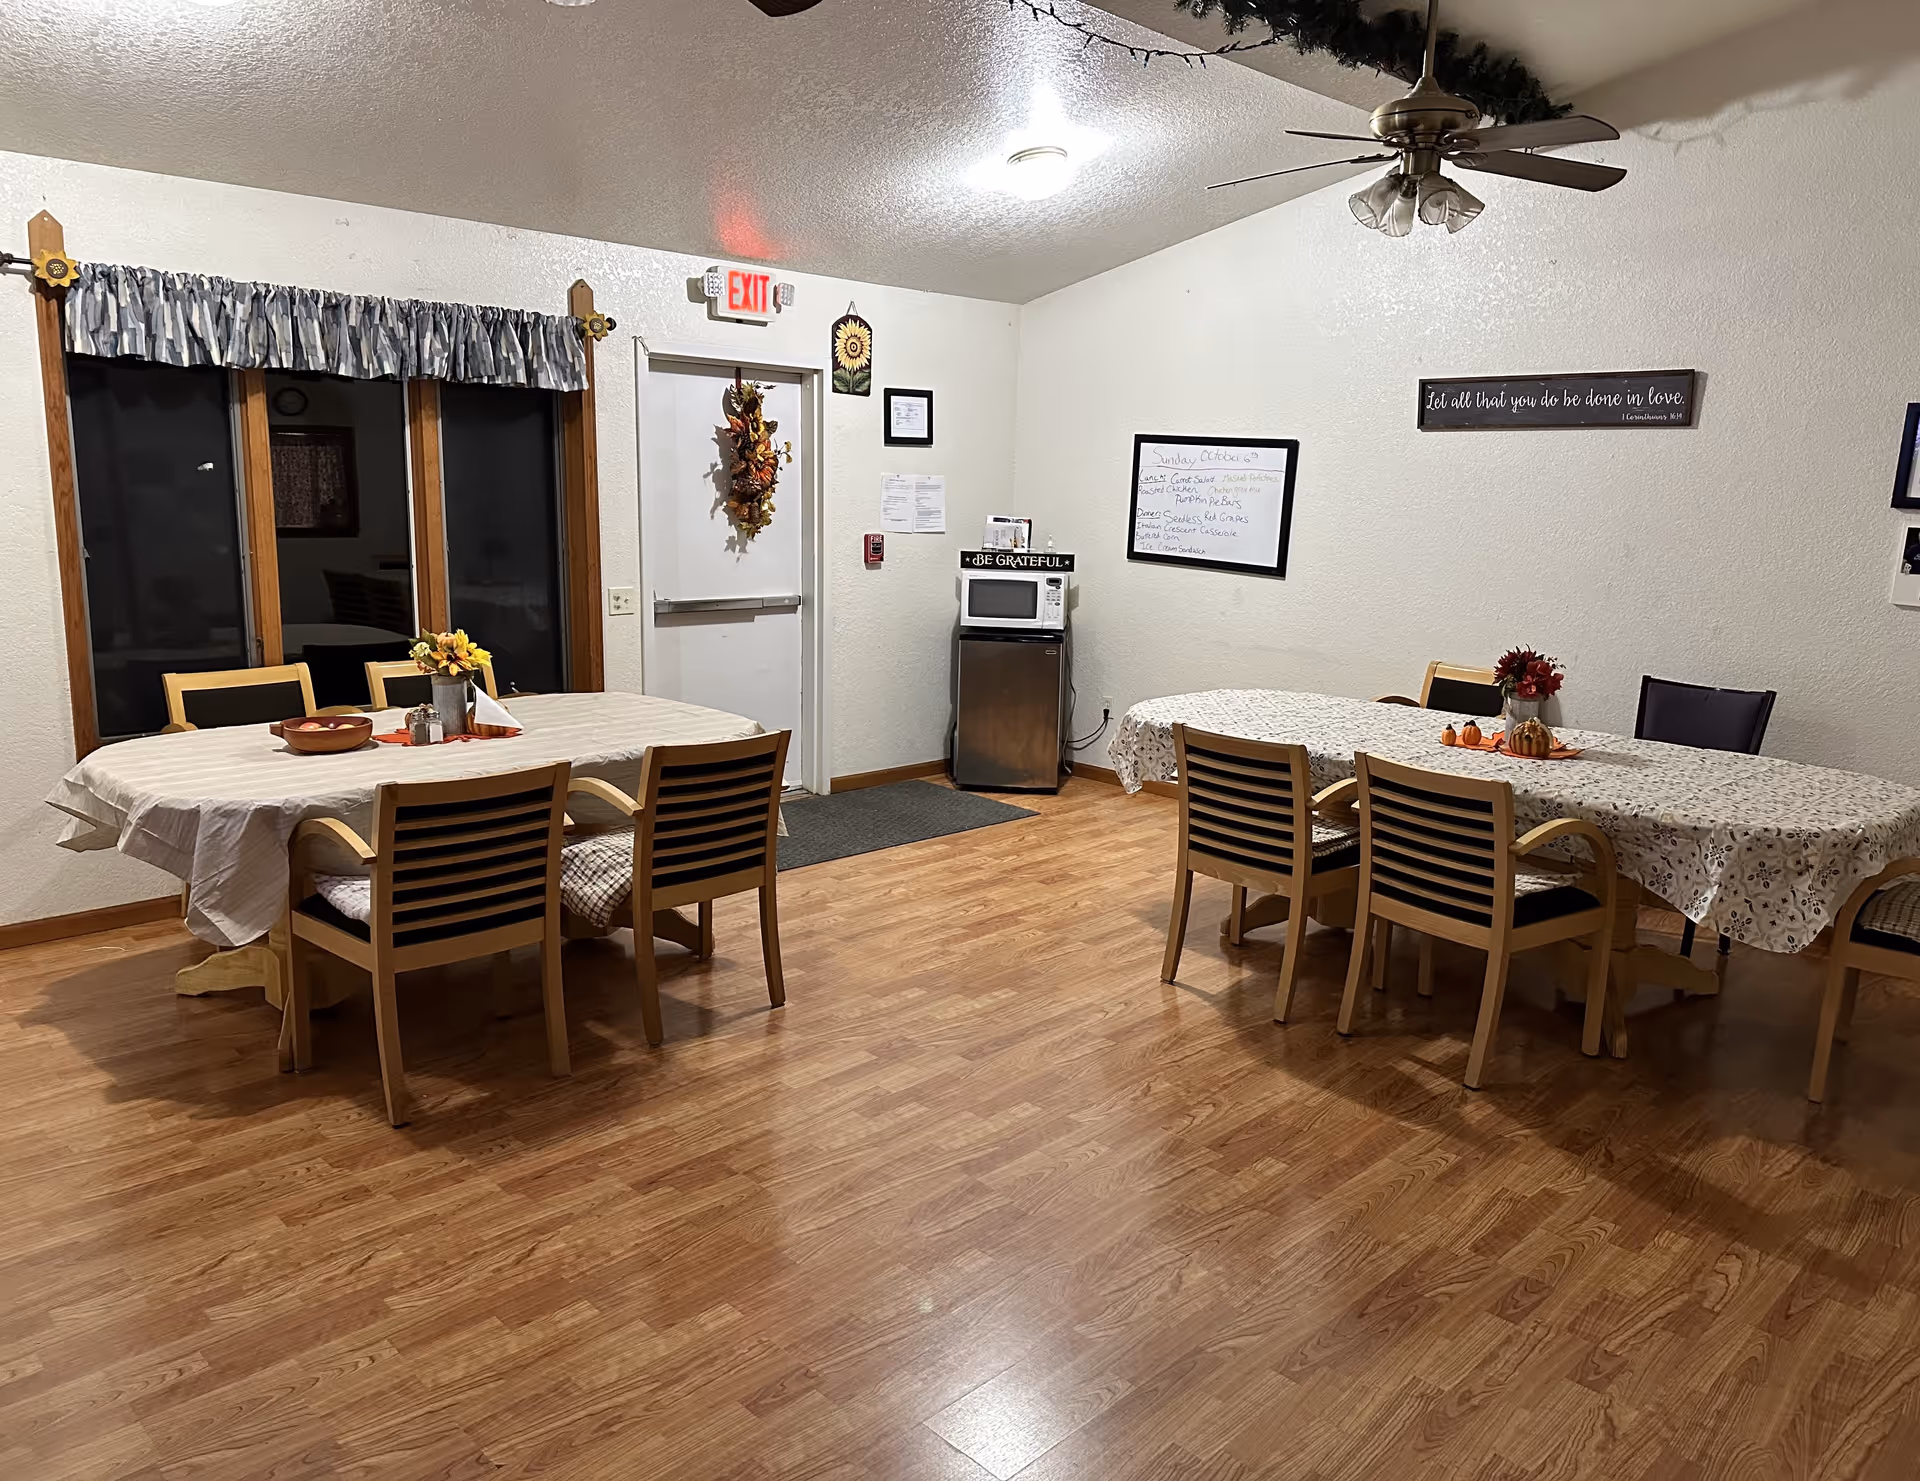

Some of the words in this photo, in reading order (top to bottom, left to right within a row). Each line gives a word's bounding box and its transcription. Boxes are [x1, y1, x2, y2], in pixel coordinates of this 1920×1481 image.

[728, 270, 770, 313] EXIT
[1425, 391, 1447, 409] Let
[1450, 391, 1472, 409] all
[1476, 391, 1507, 408] that
[1510, 394, 1537, 413] you
[1540, 389, 1559, 407] do
[1563, 389, 1582, 406] be
[1585, 388, 1623, 406] done
[1626, 389, 1644, 406] in
[1647, 386, 1686, 405] love.
[1626, 413, 1668, 421] Corinthians
[1152, 446, 1197, 469] Sunday
[1201, 447, 1239, 462] October
[1171, 472, 1193, 484] Carrot
[1194, 474, 1215, 484] Salad
[1138, 485, 1164, 495] Roasted
[1166, 485, 1198, 493] Chicken
[1209, 496, 1220, 507] Pie
[1221, 495, 1242, 509] Bars
[1163, 510, 1203, 525] Seedless
[1204, 511, 1217, 521] Red
[1219, 512, 1249, 524] Grapes
[1136, 522, 1161, 530] Italian
[1163, 524, 1197, 534] Crescent
[1200, 526, 1240, 537] Casserole
[1136, 532, 1160, 541] Buttered
[1163, 533, 1181, 541] Corn
[1140, 542, 1153, 551] Ice
[1157, 543, 1178, 552] Cream
[972, 553, 994, 566] BE
[995, 553, 1063, 568] GRATEFUL
